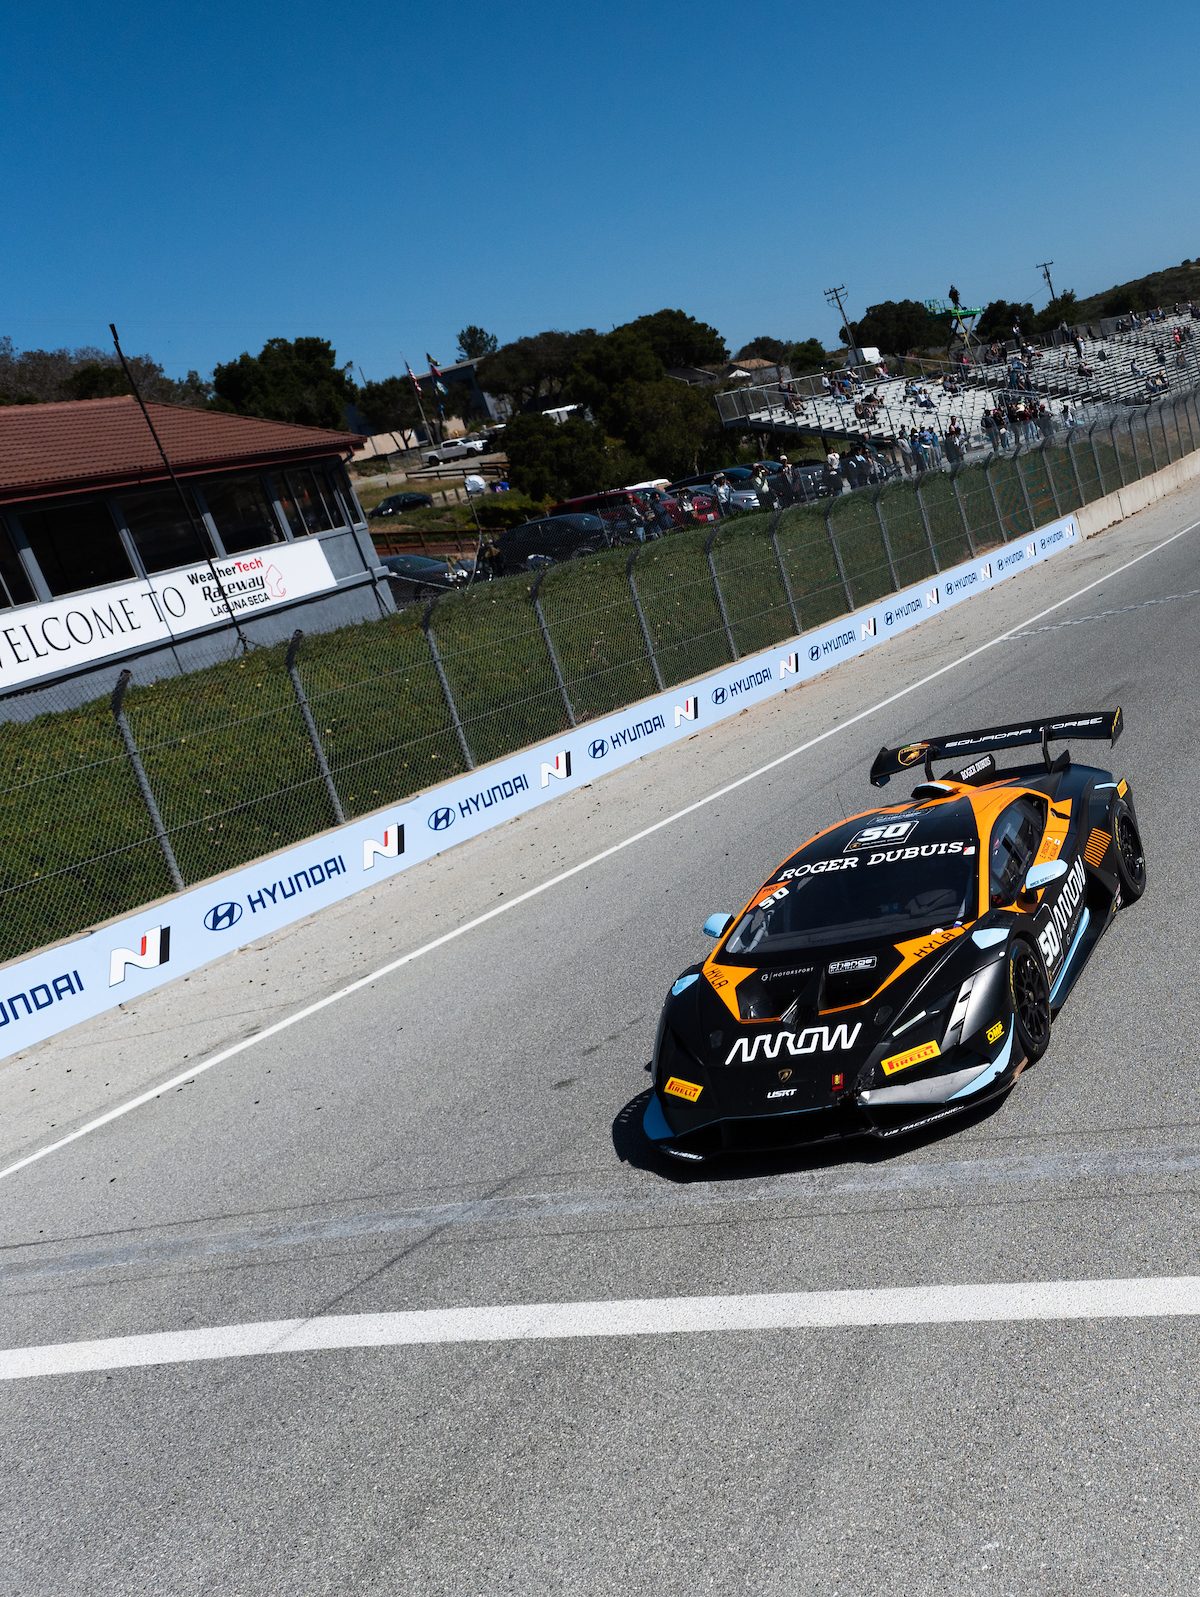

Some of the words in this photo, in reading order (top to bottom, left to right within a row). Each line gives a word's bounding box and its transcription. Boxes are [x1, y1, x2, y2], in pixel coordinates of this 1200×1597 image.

[187, 557, 263, 585] WeaherTech
[953, 572, 978, 591] HYUNDAI
[249, 592, 270, 606] SECA
[895, 597, 922, 620] HYUNDAI
[0, 598, 141, 670] ELCOME
[141, 586, 186, 623] TO
[821, 629, 857, 655] HYUNDAI
[729, 667, 773, 697] HYUNDAI
[610, 714, 665, 749] HYUNDAI
[944, 728, 1033, 748] SQUADRA
[458, 774, 529, 818] HYUNDAI
[857, 822, 912, 842] 50
[777, 856, 858, 882] ROGER
[867, 842, 964, 866] DUBUIS
[247, 855, 346, 914] HYUNDAI
[758, 886, 790, 910] 50
[913, 931, 956, 959] HYLA
[1038, 920, 1060, 968] 50
[706, 967, 729, 990] HYLA
[725, 1022, 862, 1065] ARROW
[986, 1023, 1004, 1041] OMP
[887, 1044, 935, 1071] PIRELLI
[667, 1080, 699, 1099] PIRELLI
[767, 1088, 797, 1099] USRT
